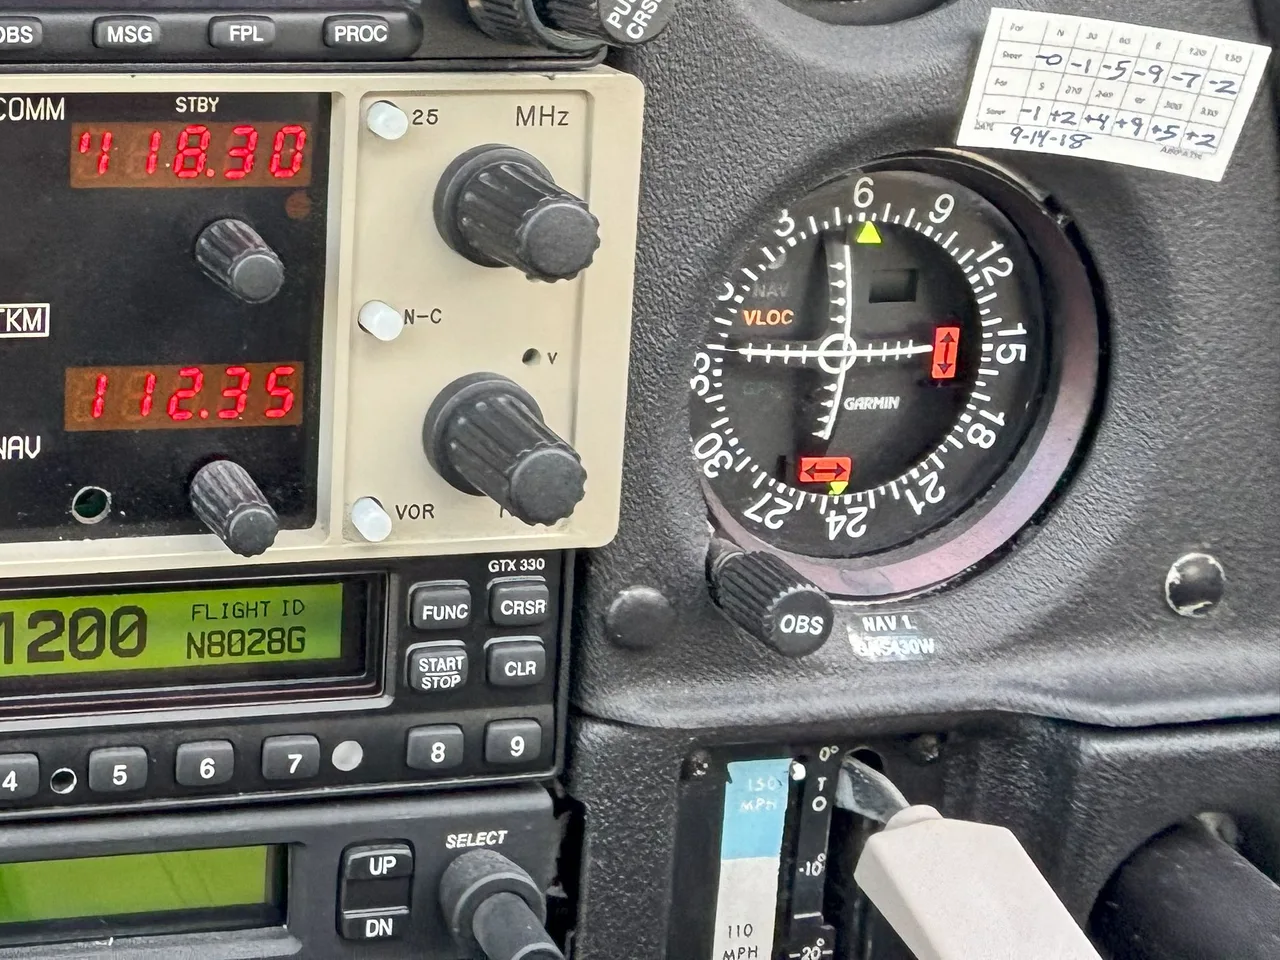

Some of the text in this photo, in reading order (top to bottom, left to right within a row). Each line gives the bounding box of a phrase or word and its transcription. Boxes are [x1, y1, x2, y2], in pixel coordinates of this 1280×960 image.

[107, 25, 153, 43] MSG
[229, 25, 264, 42] FPL
[334, 25, 388, 42] PROC
[175, 96, 220, 113] STBY
[412, 109, 439, 125] 25
[516, 105, 569, 127] MHz
[977, 240, 1014, 286] 12
[404, 308, 442, 325] N-C
[743, 309, 794, 326] VLOC
[997, 323, 1026, 363] 15
[91, 365, 295, 420] 112.35
[844, 396, 900, 410] GARMIN
[967, 411, 1005, 449] 18
[905, 471, 945, 515] 21
[395, 503, 435, 520] VOR
[743, 492, 793, 529] 27
[825, 507, 867, 540] 24
[488, 558, 545, 572] GTX 330
[192, 599, 305, 621] FLIGHT ID
[422, 603, 469, 620] FUNC
[500, 599, 546, 615] CRSR
[780, 615, 824, 633] OBS
[862, 615, 897, 631] NAV
[186, 626, 306, 660] N8028G
[419, 655, 465, 672] START
[504, 661, 537, 677] CLR
[421, 675, 461, 690] STOP
[446, 830, 508, 849] SELECT
[370, 856, 397, 876] UP
[365, 918, 393, 938] DN
[728, 923, 754, 939] 110
[723, 945, 758, 960] MPH
